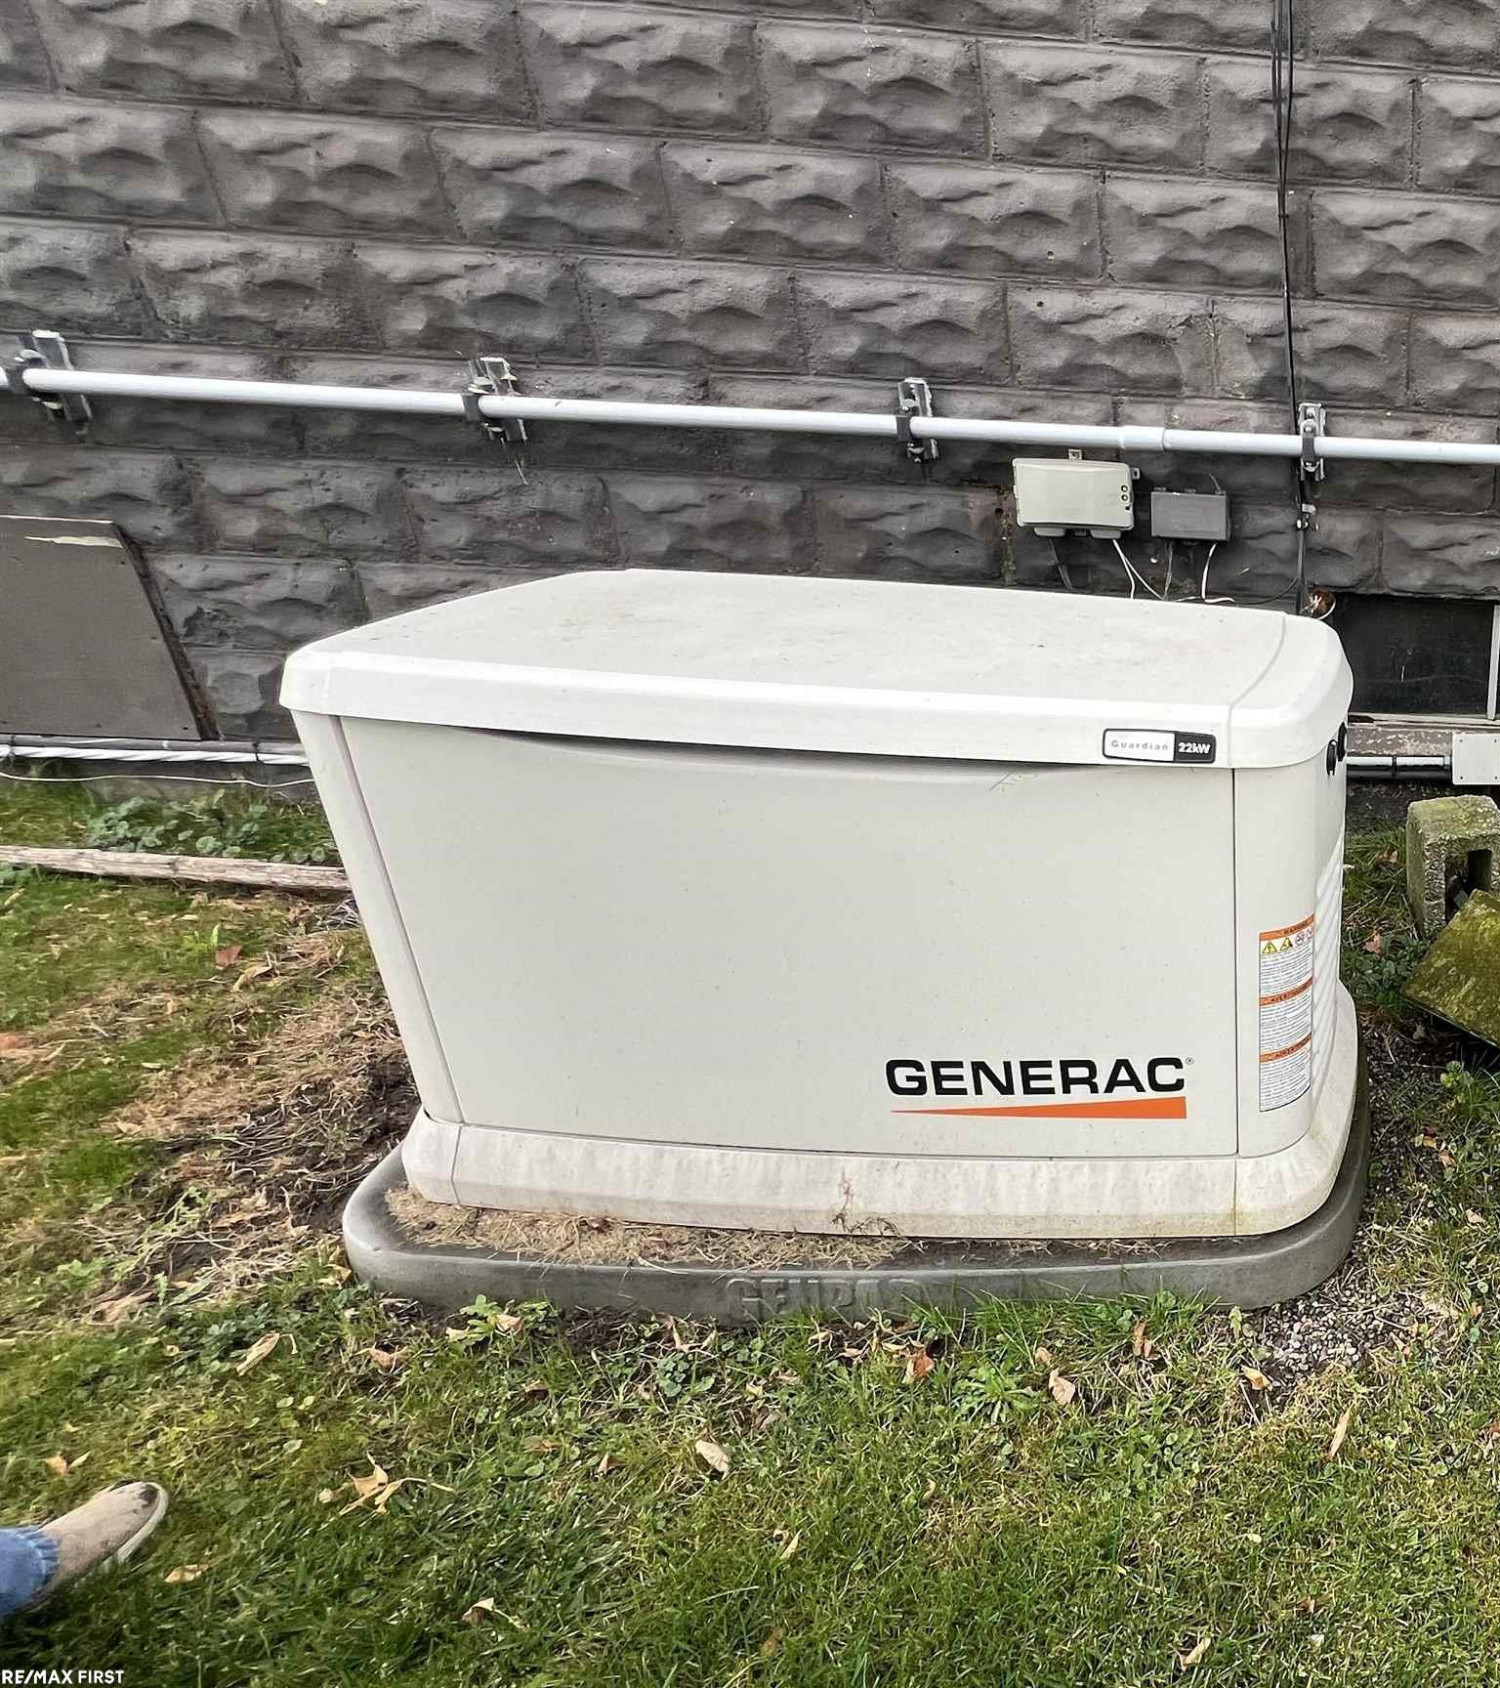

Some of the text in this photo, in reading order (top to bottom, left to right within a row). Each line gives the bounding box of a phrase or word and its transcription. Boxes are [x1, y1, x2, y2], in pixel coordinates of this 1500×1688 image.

[1111, 739, 1211, 754] Guardian 22kW
[886, 1057, 1185, 1096] GENERAC
